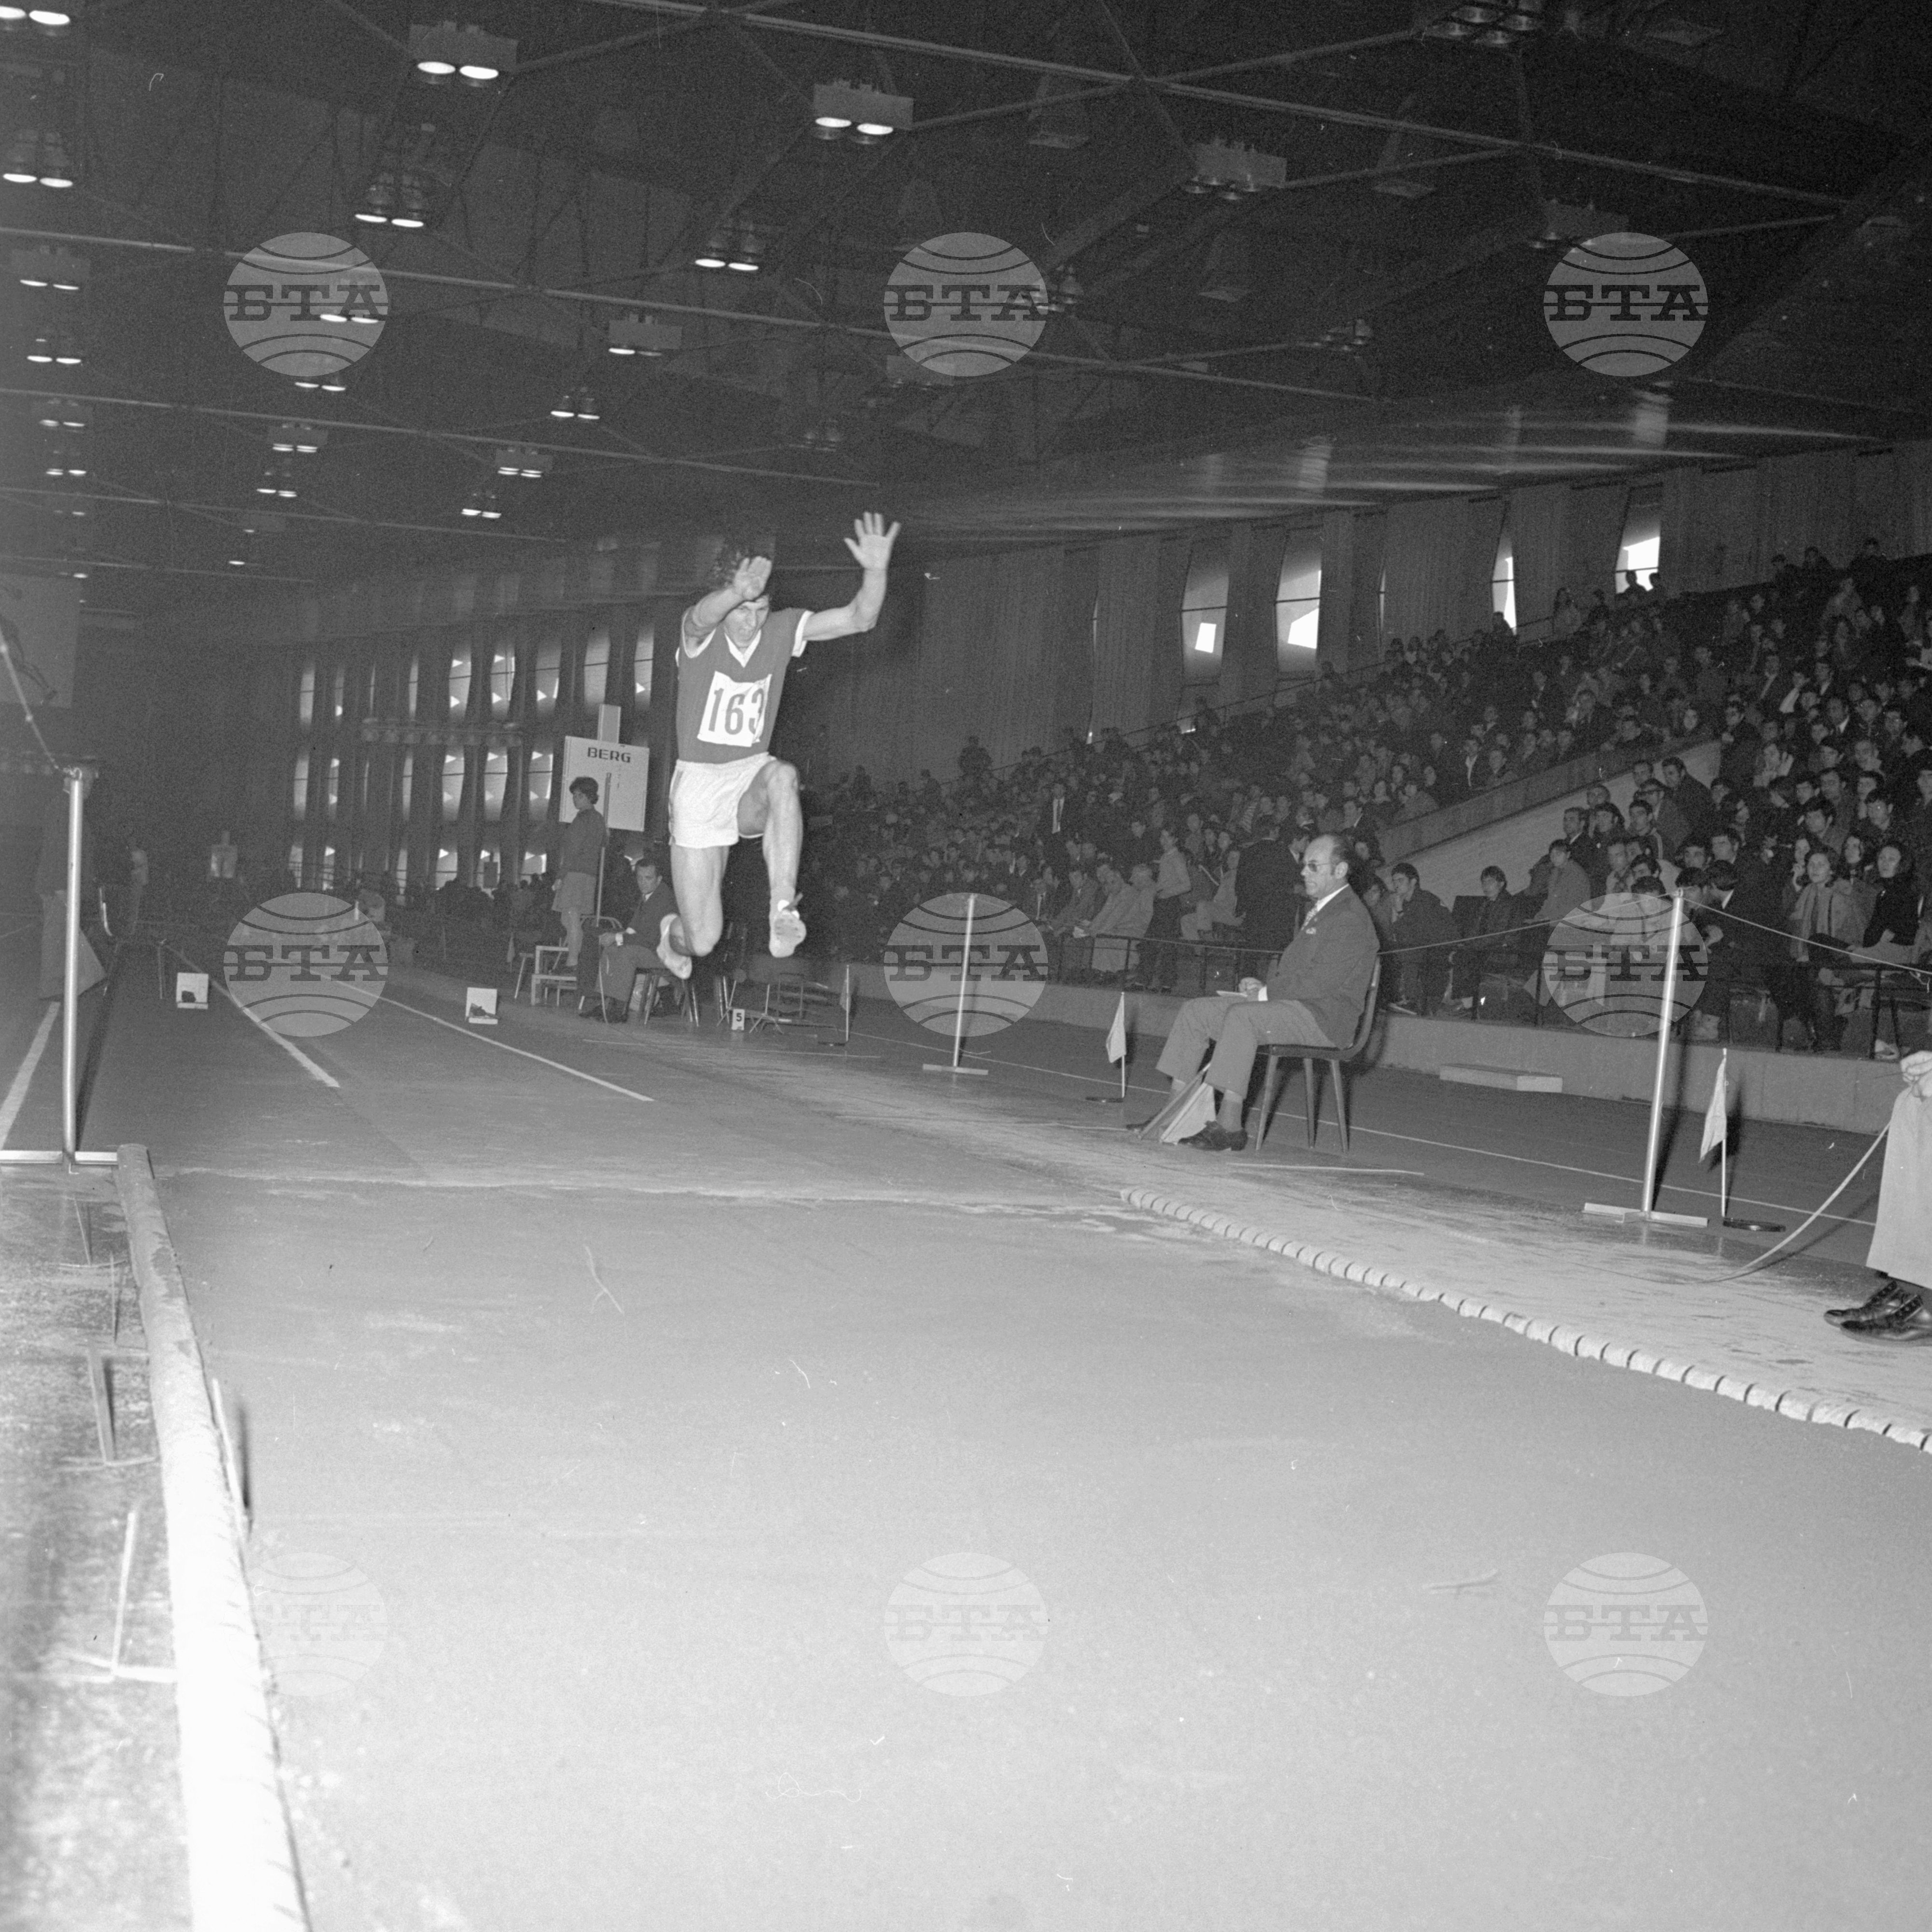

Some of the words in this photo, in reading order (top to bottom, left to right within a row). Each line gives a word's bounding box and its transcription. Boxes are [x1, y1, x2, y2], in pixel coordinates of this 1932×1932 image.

[708, 688, 765, 735] 163
[587, 747, 631, 763] BERG
[736, 1013, 742, 1022] 5
